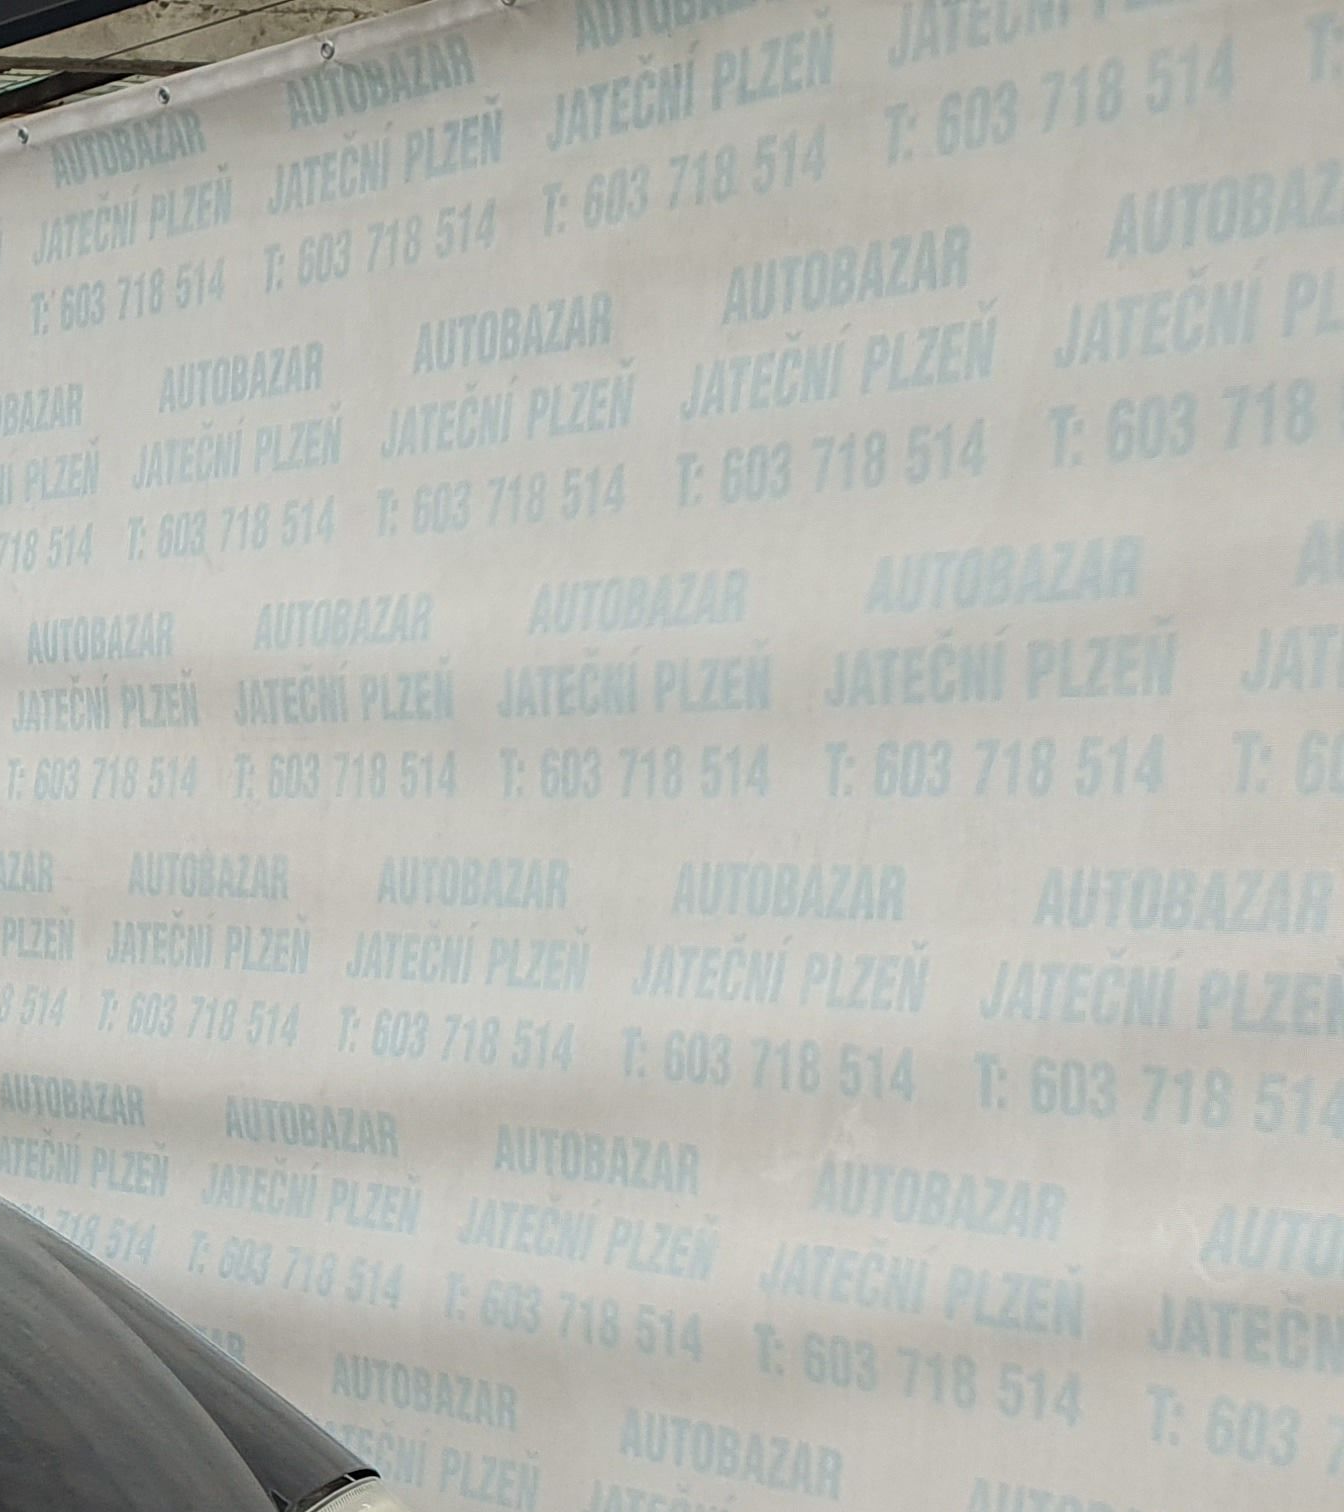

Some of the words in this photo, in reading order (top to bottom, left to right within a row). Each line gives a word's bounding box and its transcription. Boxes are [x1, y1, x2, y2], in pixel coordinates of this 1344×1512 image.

[285, 33, 474, 131] AUTOBAZAR
[546, 41, 699, 151] JATEČNÍ
[712, 8, 835, 111] PLZEŇ
[937, 78, 1019, 158] 603
[1041, 53, 1124, 134] 718
[1146, 32, 1235, 115] 514
[51, 110, 207, 188] AUTOBAZAR
[268, 121, 392, 215] JATEČNÍ
[403, 93, 503, 184] PLZEŇ
[32, 184, 139, 266] JATEČNÍ
[149, 162, 232, 240] PLZEŇ
[297, 229, 351, 286] 603
[367, 215, 422, 272] 718
[435, 197, 496, 258] 514
[61, 280, 105, 331] 603
[117, 268, 163, 320] 718
[176, 257, 225, 309] 514
[722, 223, 972, 324] AUTOBAZAR
[413, 290, 613, 376] AUTOBAZAR
[1055, 256, 1264, 369] JATEČNÍ
[158, 341, 324, 414] AUTOBAZAR
[680, 323, 852, 422] JATEČNÍ
[863, 297, 998, 395] PLZEŇ
[133, 417, 244, 489] JATEČNÍ
[254, 402, 342, 473] PLZEŇ
[381, 376, 517, 459] JATEČNÍ
[527, 357, 637, 440] PLZEŇ
[25, 435, 100, 502] PLZEŇ
[412, 480, 471, 534] 603
[487, 472, 547, 527] 718
[562, 463, 625, 521] 514
[721, 441, 793, 506] 603
[814, 430, 888, 494] 718
[906, 418, 986, 485] 514
[158, 508, 207, 558] 603
[221, 503, 271, 552] 718
[281, 495, 336, 547] 514
[527, 567, 749, 635] AUTOBAZAR
[864, 534, 1144, 614] AUTOBAZAR
[27, 610, 175, 665] AUTOBAZAR
[254, 592, 434, 651] AUTOBAZAR
[823, 623, 1010, 707] JATEČNÍ
[1025, 612, 1178, 698] PLZEŇ
[13, 672, 111, 733] JATEČNÍ
[120, 668, 199, 730] PLZEŇ
[234, 659, 348, 727] JATEČNÍ
[361, 650, 455, 721] PLZEŇ
[497, 645, 643, 717] JATEČNÍ
[654, 639, 773, 713] PLZEŇ
[33, 757, 80, 800] 603
[92, 757, 136, 800] 718
[147, 756, 197, 798] 514
[540, 746, 601, 799] 603
[619, 744, 682, 799] 718
[702, 743, 770, 799] 514
[873, 739, 952, 797] 603
[976, 736, 1056, 797] 718
[1075, 734, 1165, 795] 514
[128, 851, 288, 902] AUTOBAZAR
[377, 855, 569, 910] AUTOBAZAR
[671, 860, 908, 921] AUTOBAZAR
[1031, 866, 1337, 933] AUTOBAZAR
[1, 905, 74, 960] PLZEŇ
[106, 907, 216, 969] JATEČNÍ
[224, 912, 310, 975] PLZEŇ
[345, 919, 479, 985] JATEČNÍ
[485, 925, 591, 991] PLZEŇ
[632, 932, 794, 1003] JATEČNÍ
[799, 940, 930, 1013] PLZEŇ
[978, 948, 1185, 1028] JATEČNÍ
[127, 991, 178, 1038] 603
[187, 997, 237, 1041] 718
[246, 1000, 300, 1048] 514
[0, 1072, 145, 1127] AUTOBAZAR
[664, 1028, 732, 1085] 603
[750, 1038, 821, 1094] 718
[839, 1043, 915, 1101] 514
[225, 1098, 400, 1158] AUTOBAZAR
[494, 1122, 700, 1196] AUTOBAZAR
[90, 1140, 169, 1198] PLZEŇ
[202, 1155, 319, 1219] JATEČNÍ
[326, 1173, 423, 1235] PLZEŇ
[813, 1156, 1067, 1242] AUTOBAZAR
[457, 1192, 600, 1262] JATEČNÍ
[603, 1211, 719, 1282] PLZEŇ
[482, 1278, 542, 1335] 603
[560, 1290, 620, 1349] 718
[637, 1303, 702, 1362] 514
[762, 1233, 939, 1317] JATEČNÍ
[942, 1262, 1084, 1343] PLZEŇ
[331, 1352, 517, 1431] AUTOBAZAR
[440, 1449, 542, 1512] PLZEŇ
[620, 1408, 843, 1500] AUTOBAZAR
